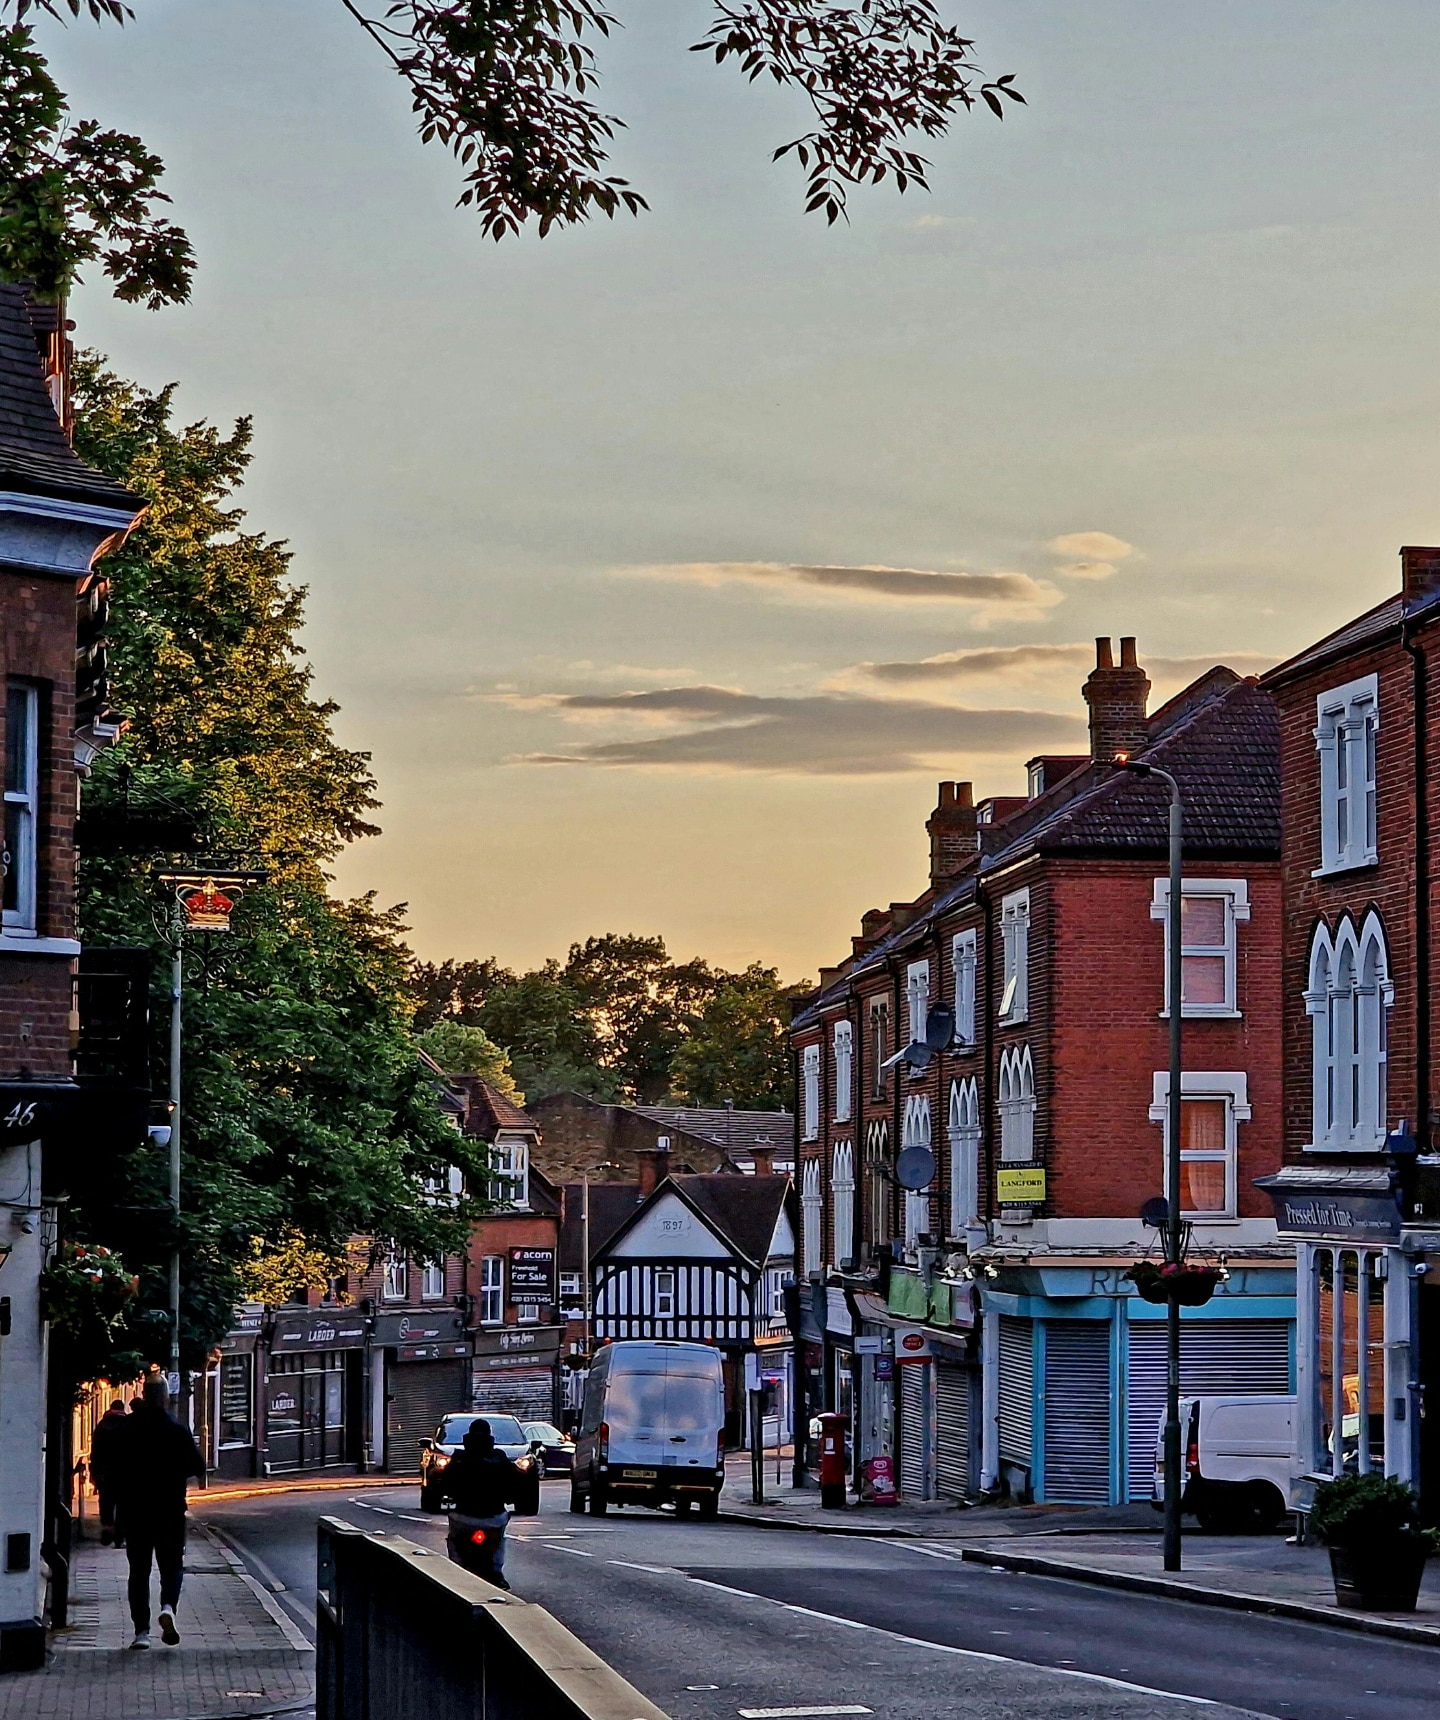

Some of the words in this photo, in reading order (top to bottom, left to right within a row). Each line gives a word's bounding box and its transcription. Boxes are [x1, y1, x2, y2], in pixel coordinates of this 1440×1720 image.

[3, 1101, 38, 1128] 46
[1001, 1179, 1043, 1188] LANGFORD
[1285, 1201, 1318, 1224] Pressed
[1315, 1202, 1330, 1226] for
[1328, 1203, 1353, 1227] Time
[662, 1220, 683, 1231] 1897
[523, 1251, 552, 1259] acorn
[511, 1272, 527, 1280] For
[528, 1272, 547, 1281] Sale
[308, 1329, 335, 1343] LARDER
[271, 1398, 295, 1410] LARDER
